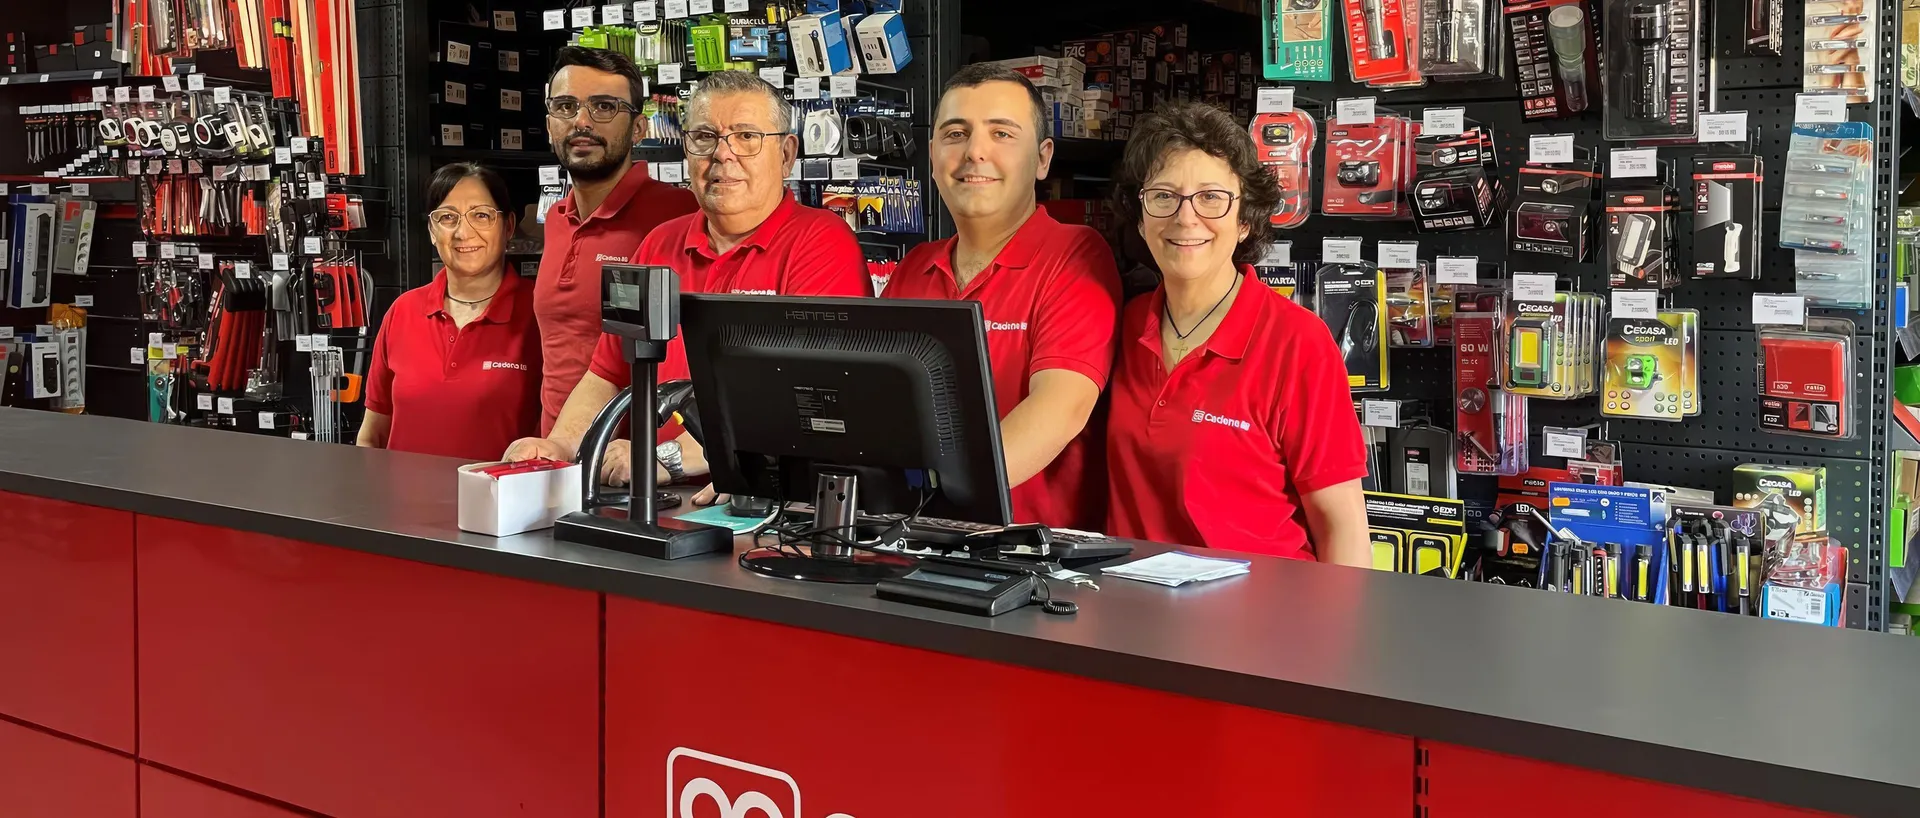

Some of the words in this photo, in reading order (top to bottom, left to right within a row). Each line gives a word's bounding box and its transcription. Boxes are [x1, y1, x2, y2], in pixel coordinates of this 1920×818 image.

[1518, 303, 1554, 313] CEGASA
[1550, 314, 1563, 322] LED
[1623, 324, 1666, 335] CEGASA
[1635, 335, 1656, 343] sport
[1664, 337, 1679, 346] LED
[1460, 343, 1475, 353] 60
[1478, 343, 1489, 353] W
[1204, 413, 1240, 428] Cadena
[1759, 478, 1792, 488] CEGASA
[1439, 506, 1457, 515] EDM
[1516, 503, 1529, 513] LED
